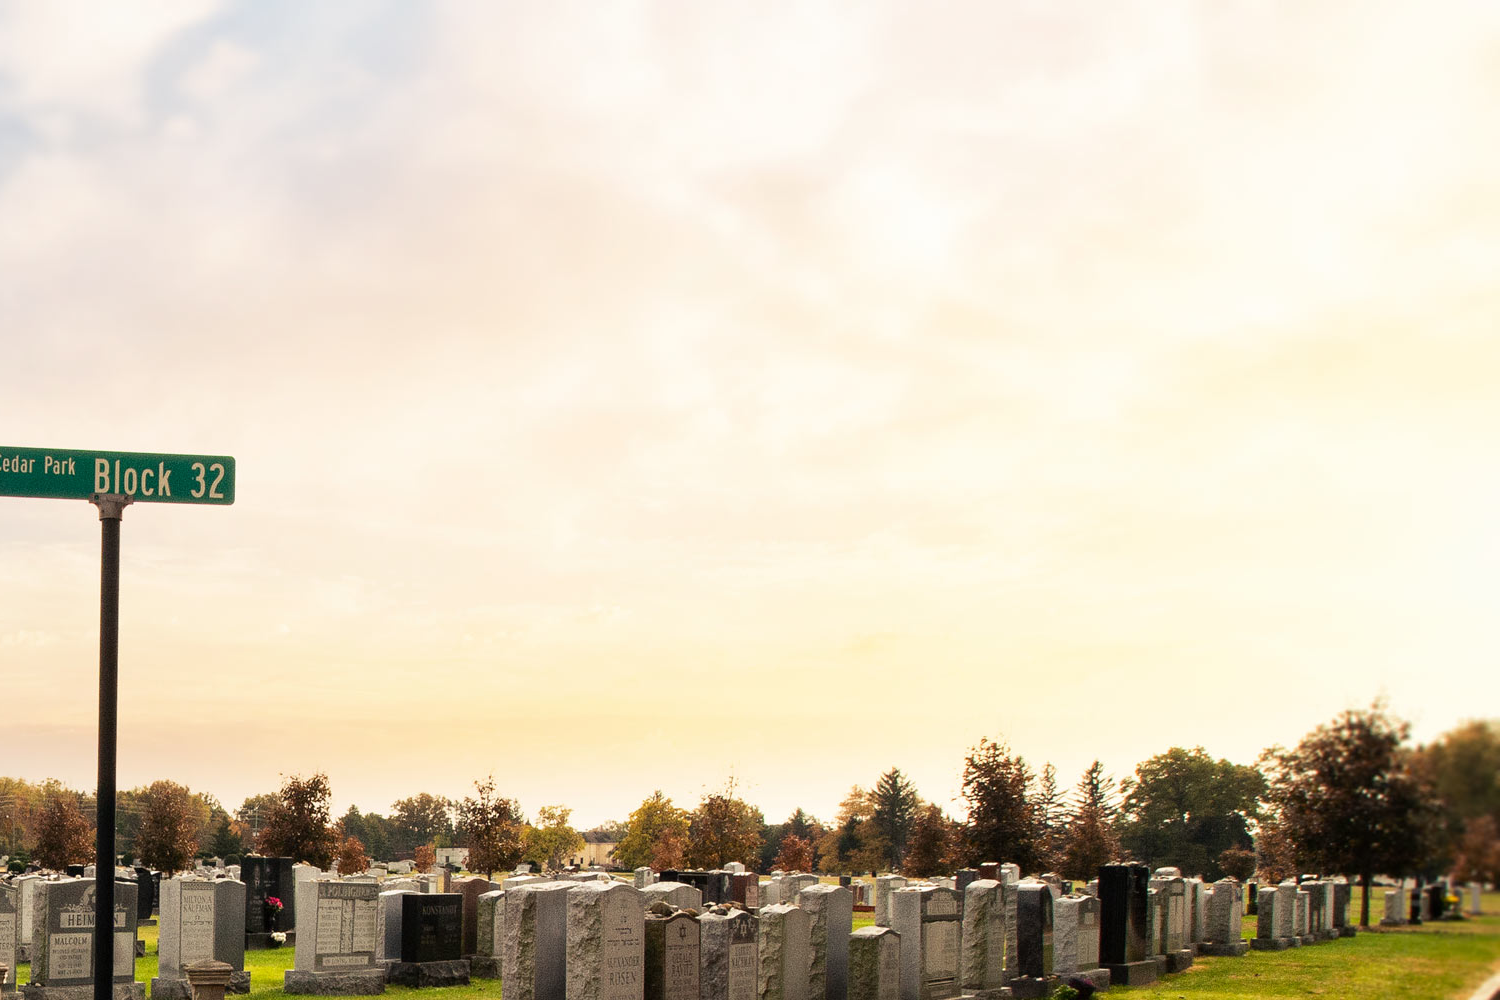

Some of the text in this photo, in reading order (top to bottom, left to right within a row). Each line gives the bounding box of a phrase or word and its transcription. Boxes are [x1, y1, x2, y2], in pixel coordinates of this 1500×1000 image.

[44, 455, 76, 476] Park
[94, 458, 226, 499] Block 32
[54, 937, 88, 946] MALCOLM
[609, 971, 636, 985] ROSEN
